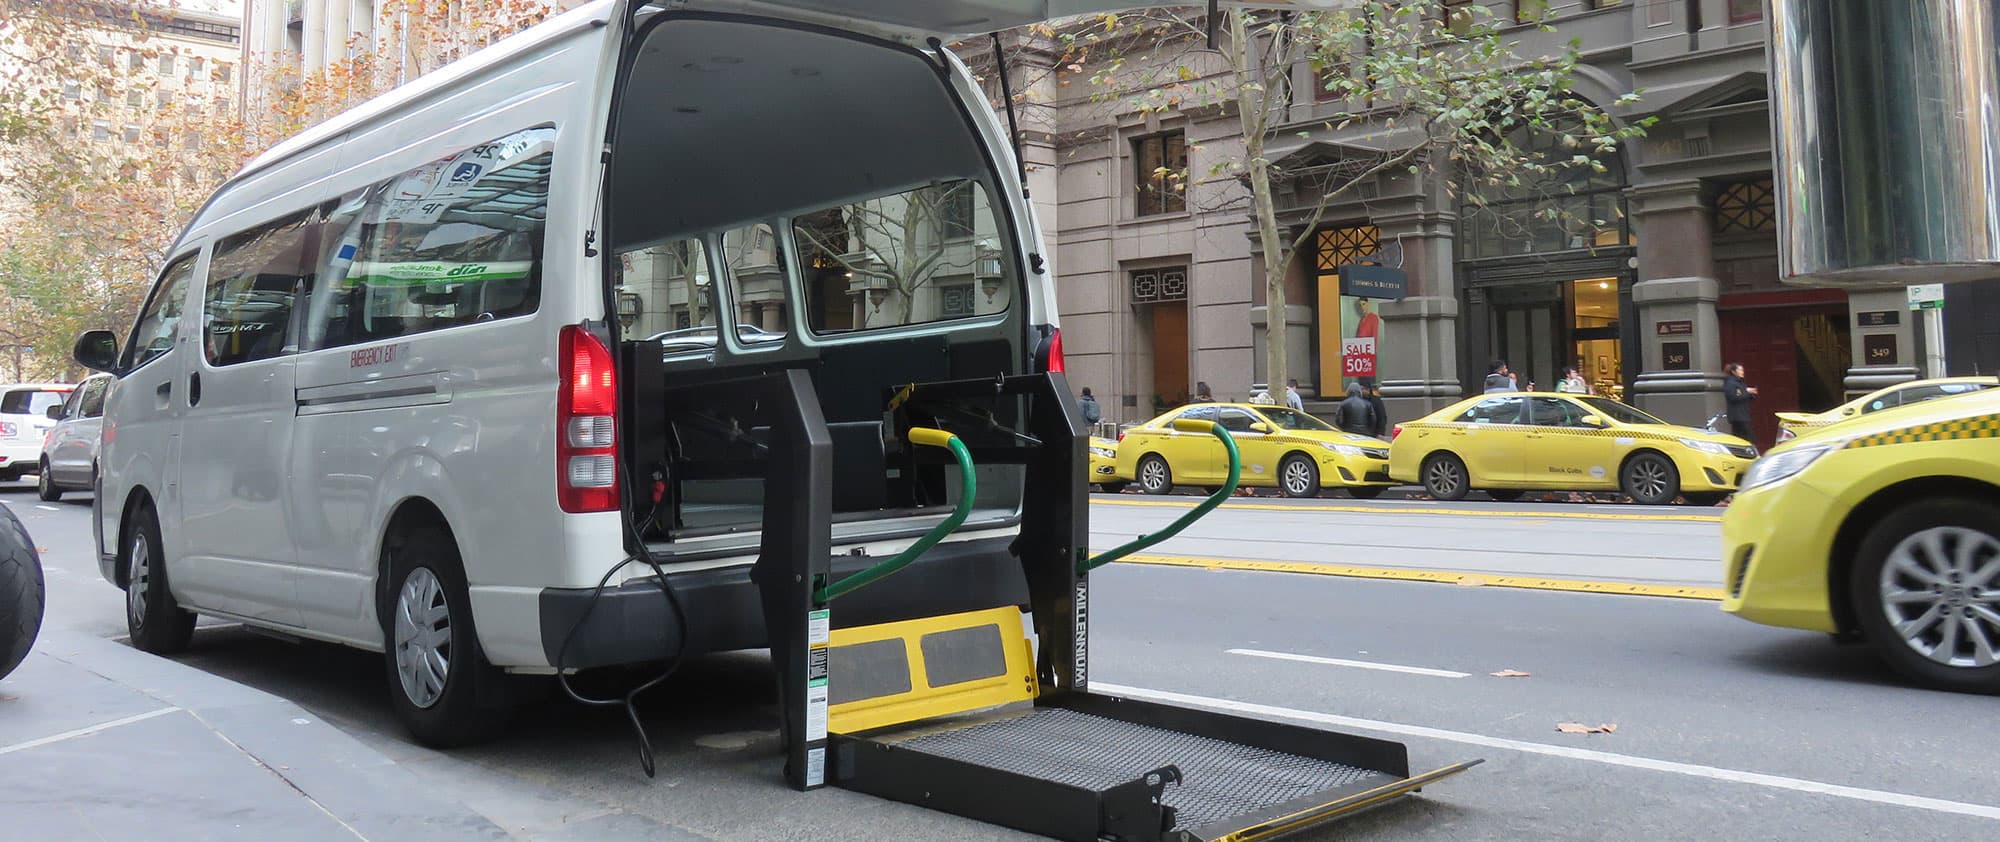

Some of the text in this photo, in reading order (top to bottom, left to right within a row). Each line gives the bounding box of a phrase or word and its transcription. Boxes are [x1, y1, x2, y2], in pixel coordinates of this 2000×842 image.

[351, 344, 398, 368] EMERGENCY EXIT
[1346, 344, 1371, 355] SALE
[1872, 348, 1890, 358] 349
[1346, 358, 1372, 373] 50%
[1075, 585, 1087, 685] MILLENNIUM
